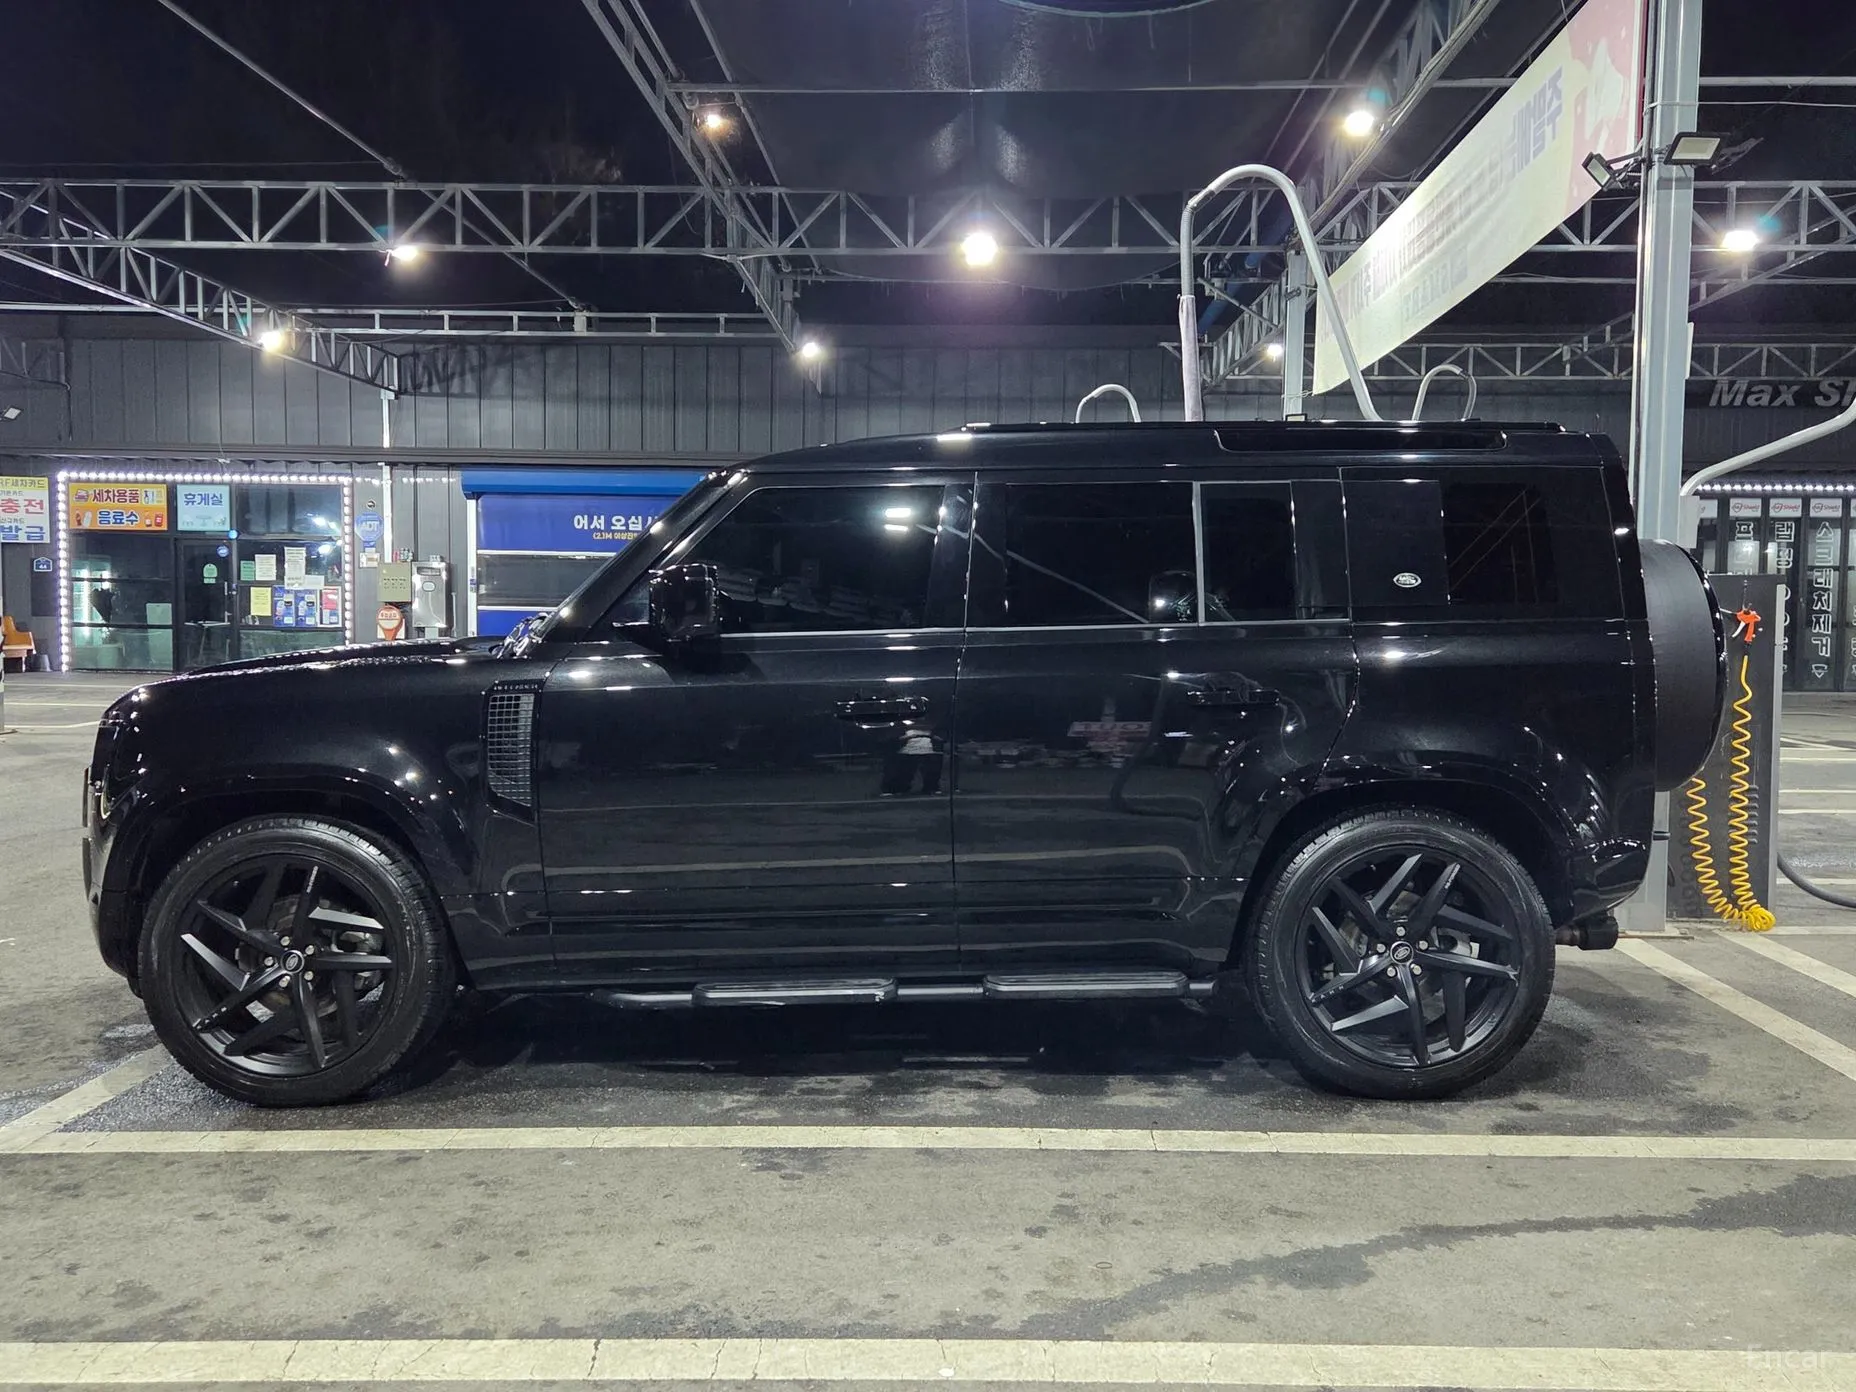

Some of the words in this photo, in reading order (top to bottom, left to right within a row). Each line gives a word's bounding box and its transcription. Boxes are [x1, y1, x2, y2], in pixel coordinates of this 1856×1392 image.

[1709, 379, 1800, 407] Max
[92, 488, 140, 504] 세차용품
[184, 492, 223, 507] 휴게실
[98, 510, 139, 525] 음료수
[573, 514, 605, 530] 어서
